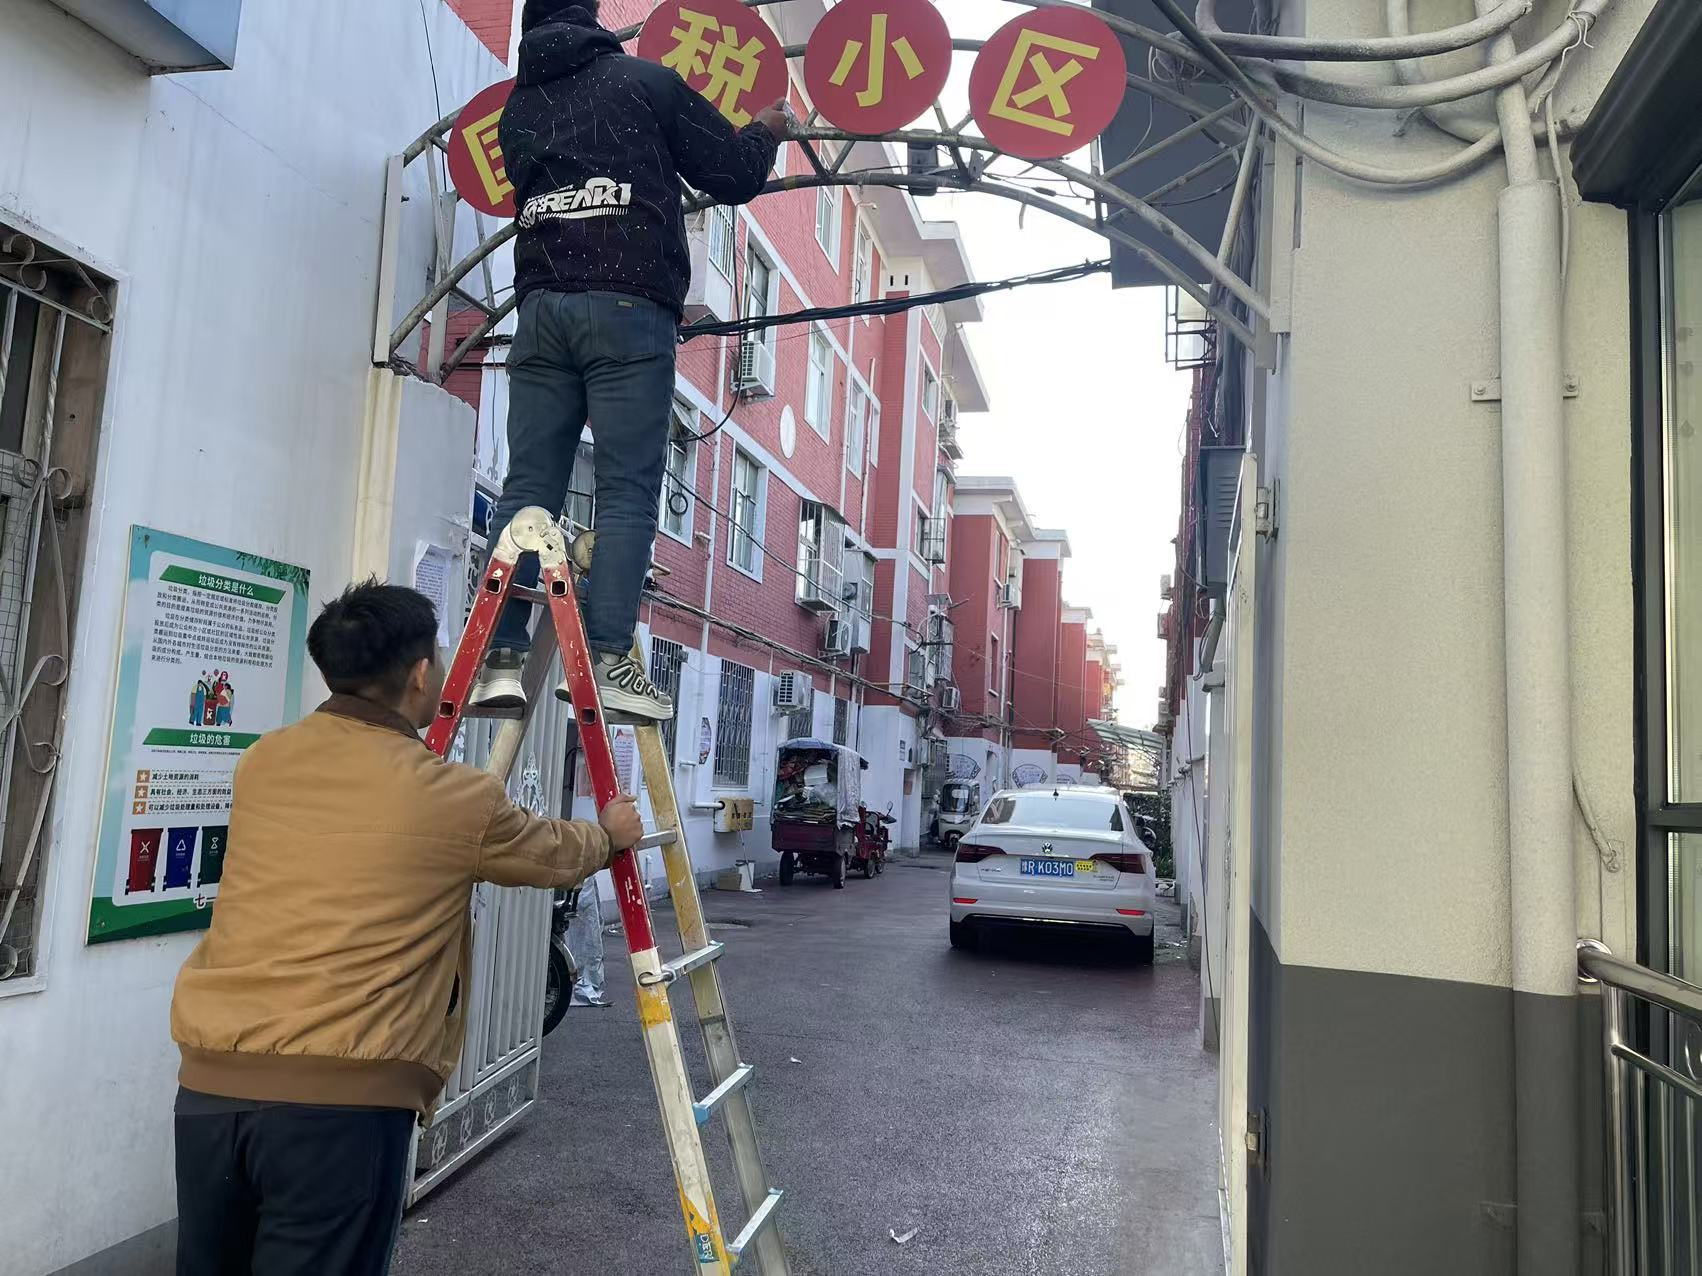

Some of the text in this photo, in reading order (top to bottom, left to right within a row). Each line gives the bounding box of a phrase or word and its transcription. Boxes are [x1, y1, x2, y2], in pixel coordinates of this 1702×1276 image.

[198, 574, 255, 597] 垃圾分类是什么
[190, 732, 231, 746] 垃圾的危害
